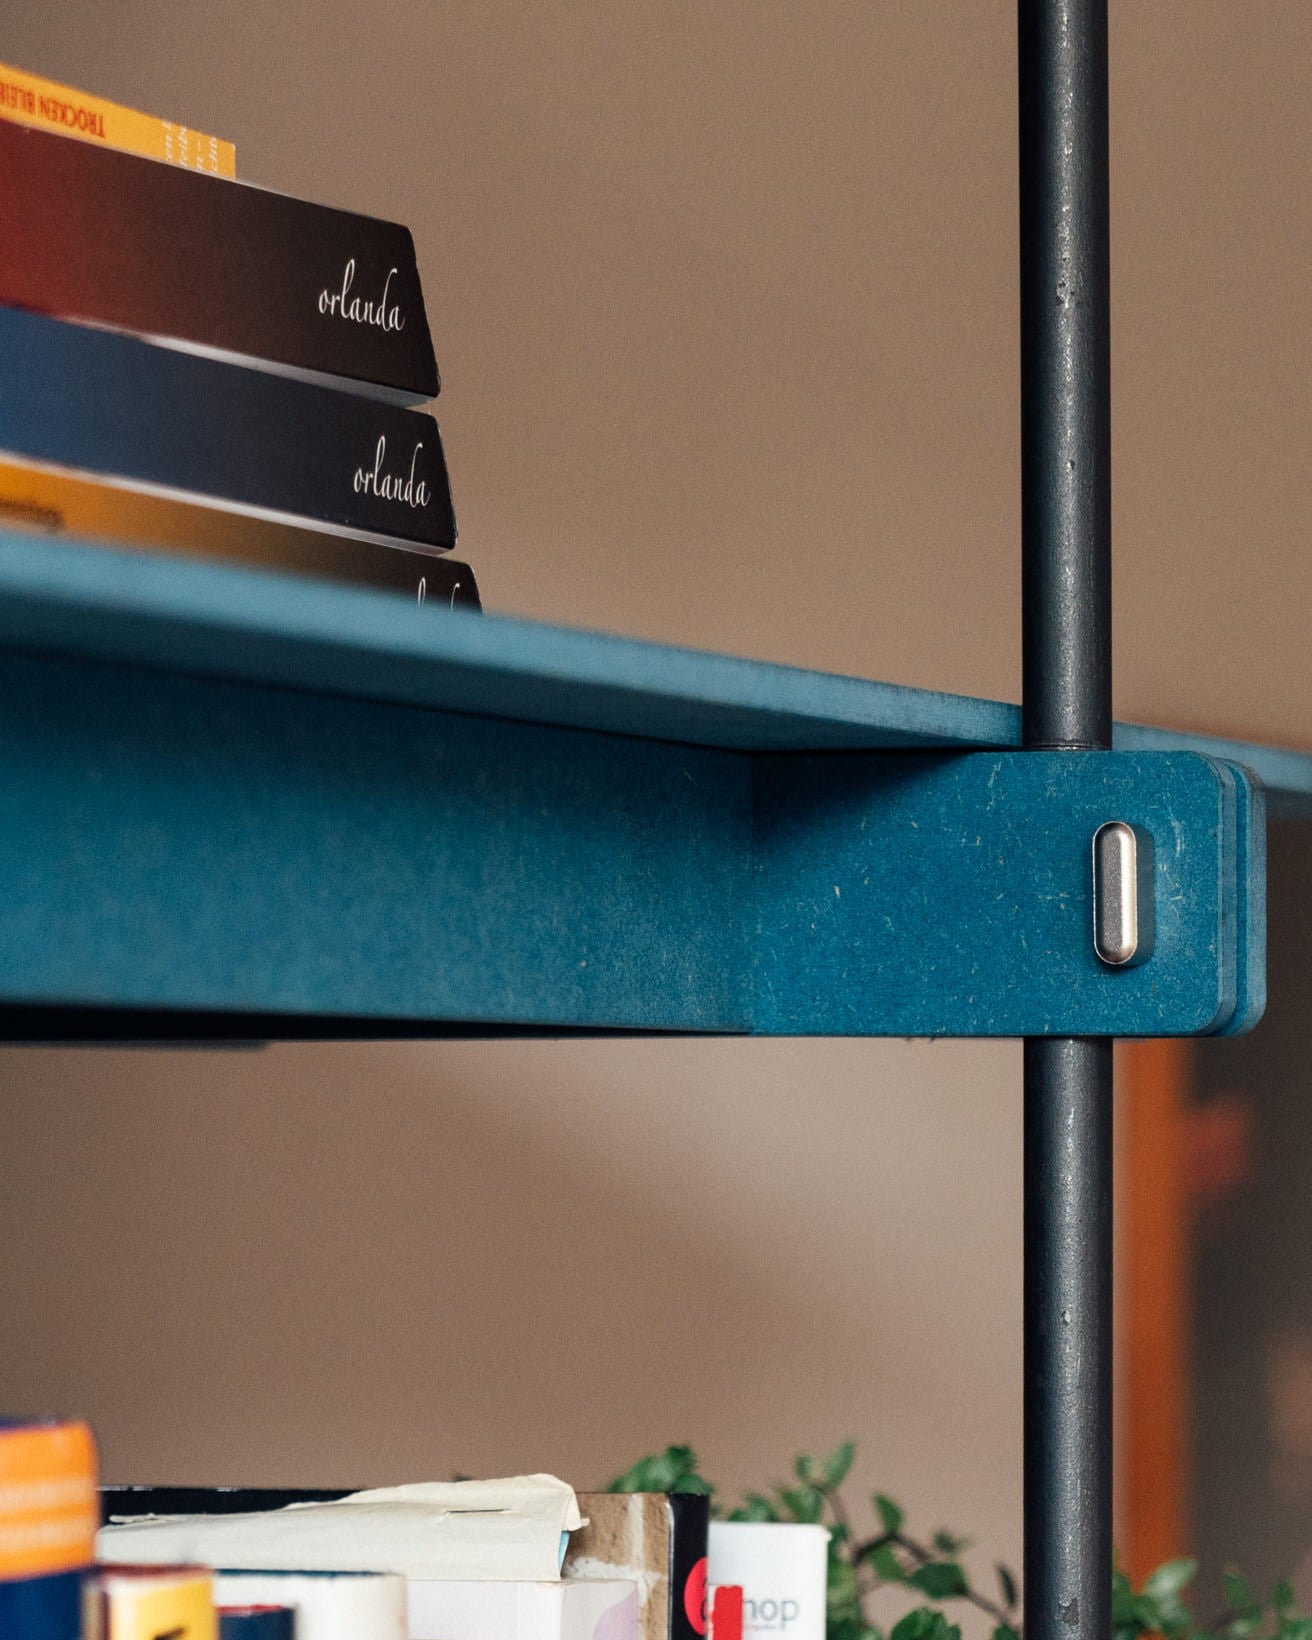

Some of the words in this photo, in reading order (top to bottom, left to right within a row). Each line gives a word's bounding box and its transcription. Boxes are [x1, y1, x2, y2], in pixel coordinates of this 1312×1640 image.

[39, 96, 106, 139] TROCKEN
[318, 258, 406, 332] orlanda
[353, 434, 432, 508] orlanda
